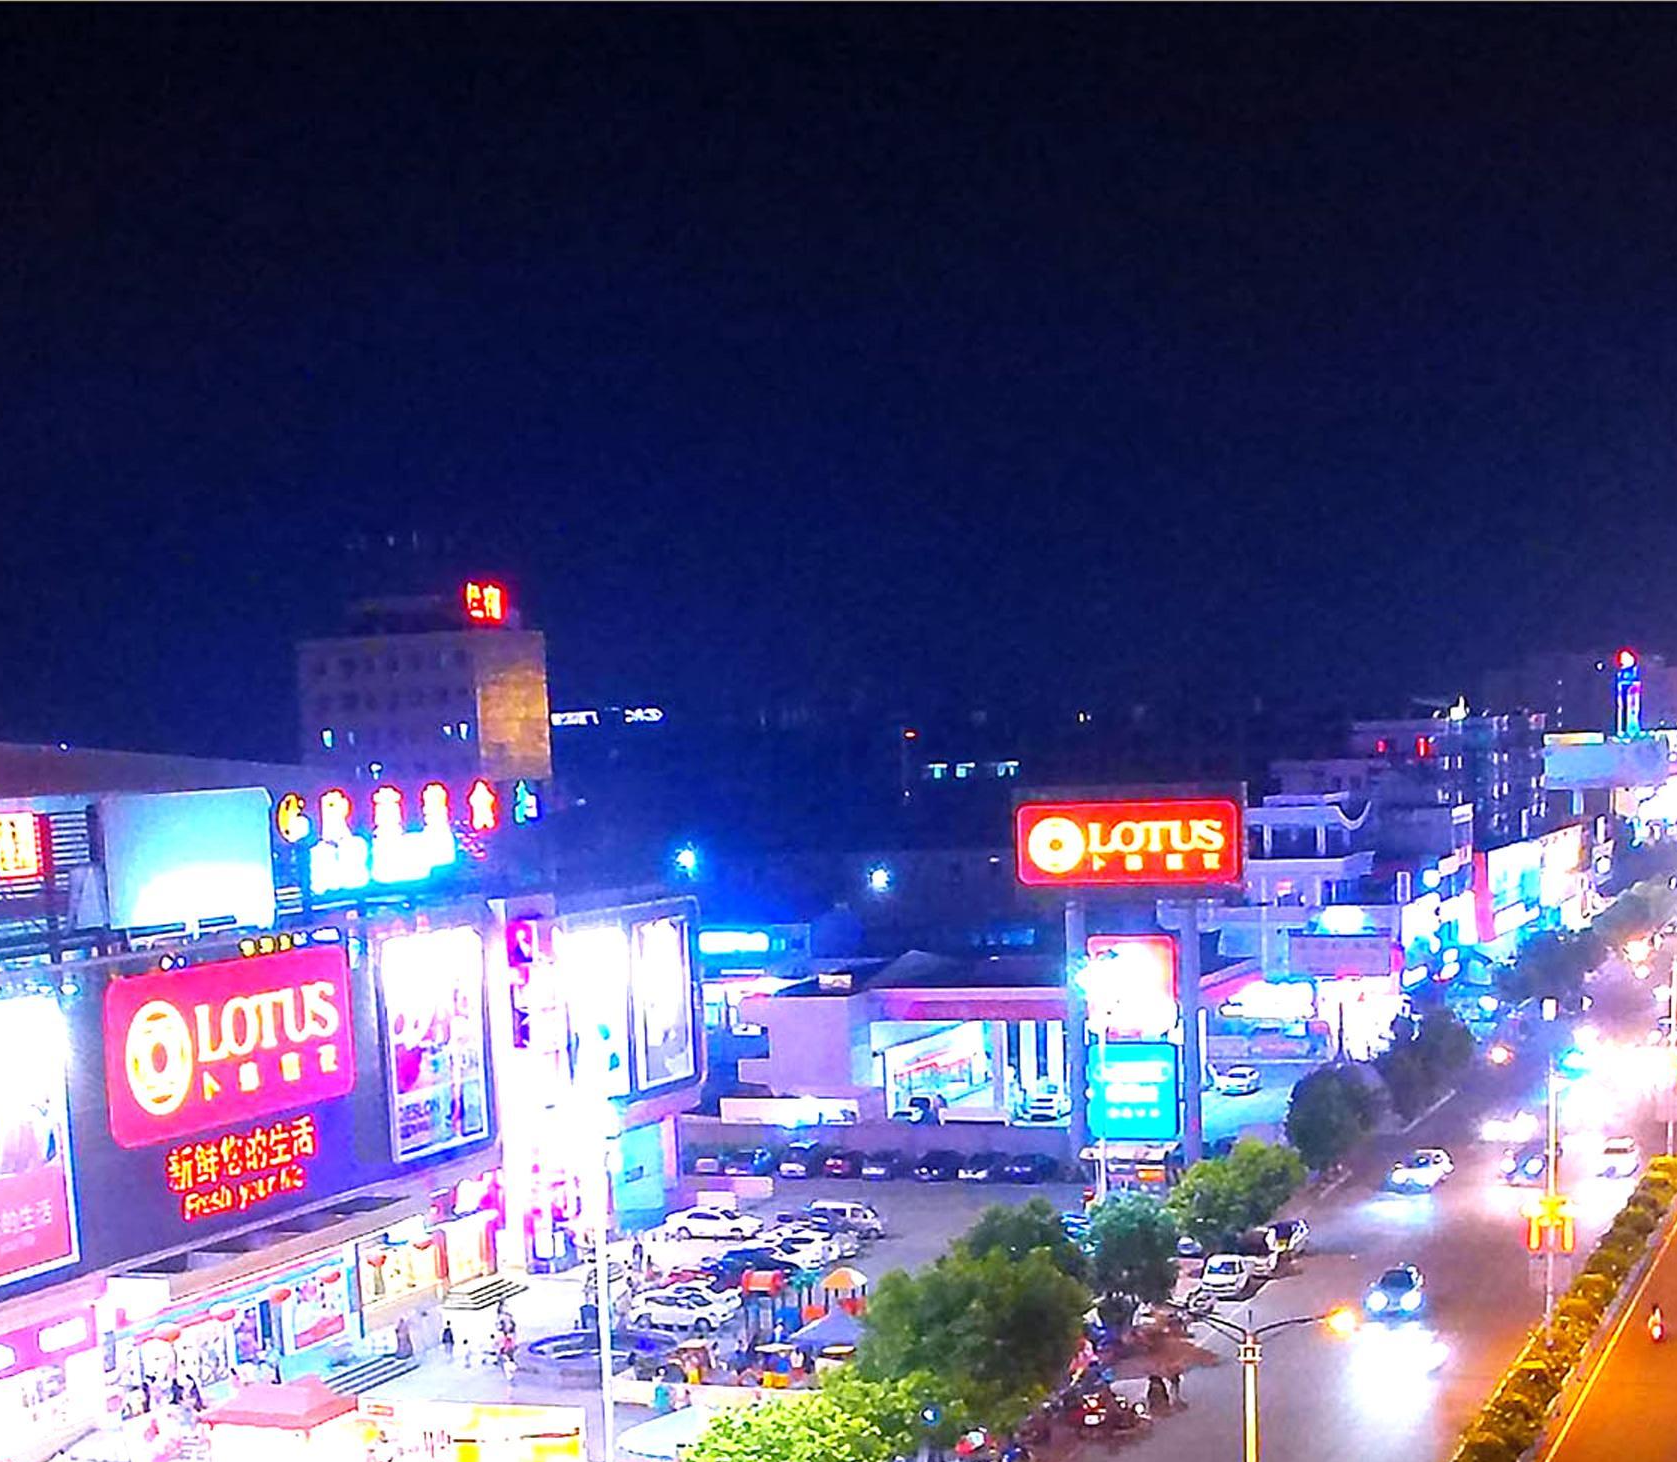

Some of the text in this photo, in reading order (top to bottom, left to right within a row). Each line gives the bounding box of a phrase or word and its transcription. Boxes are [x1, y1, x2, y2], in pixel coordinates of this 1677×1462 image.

[1087, 818, 1225, 854] LOTUS
[193, 980, 339, 1063] LOTUS
[167, 1115, 315, 1191] 新鲜您的生活
